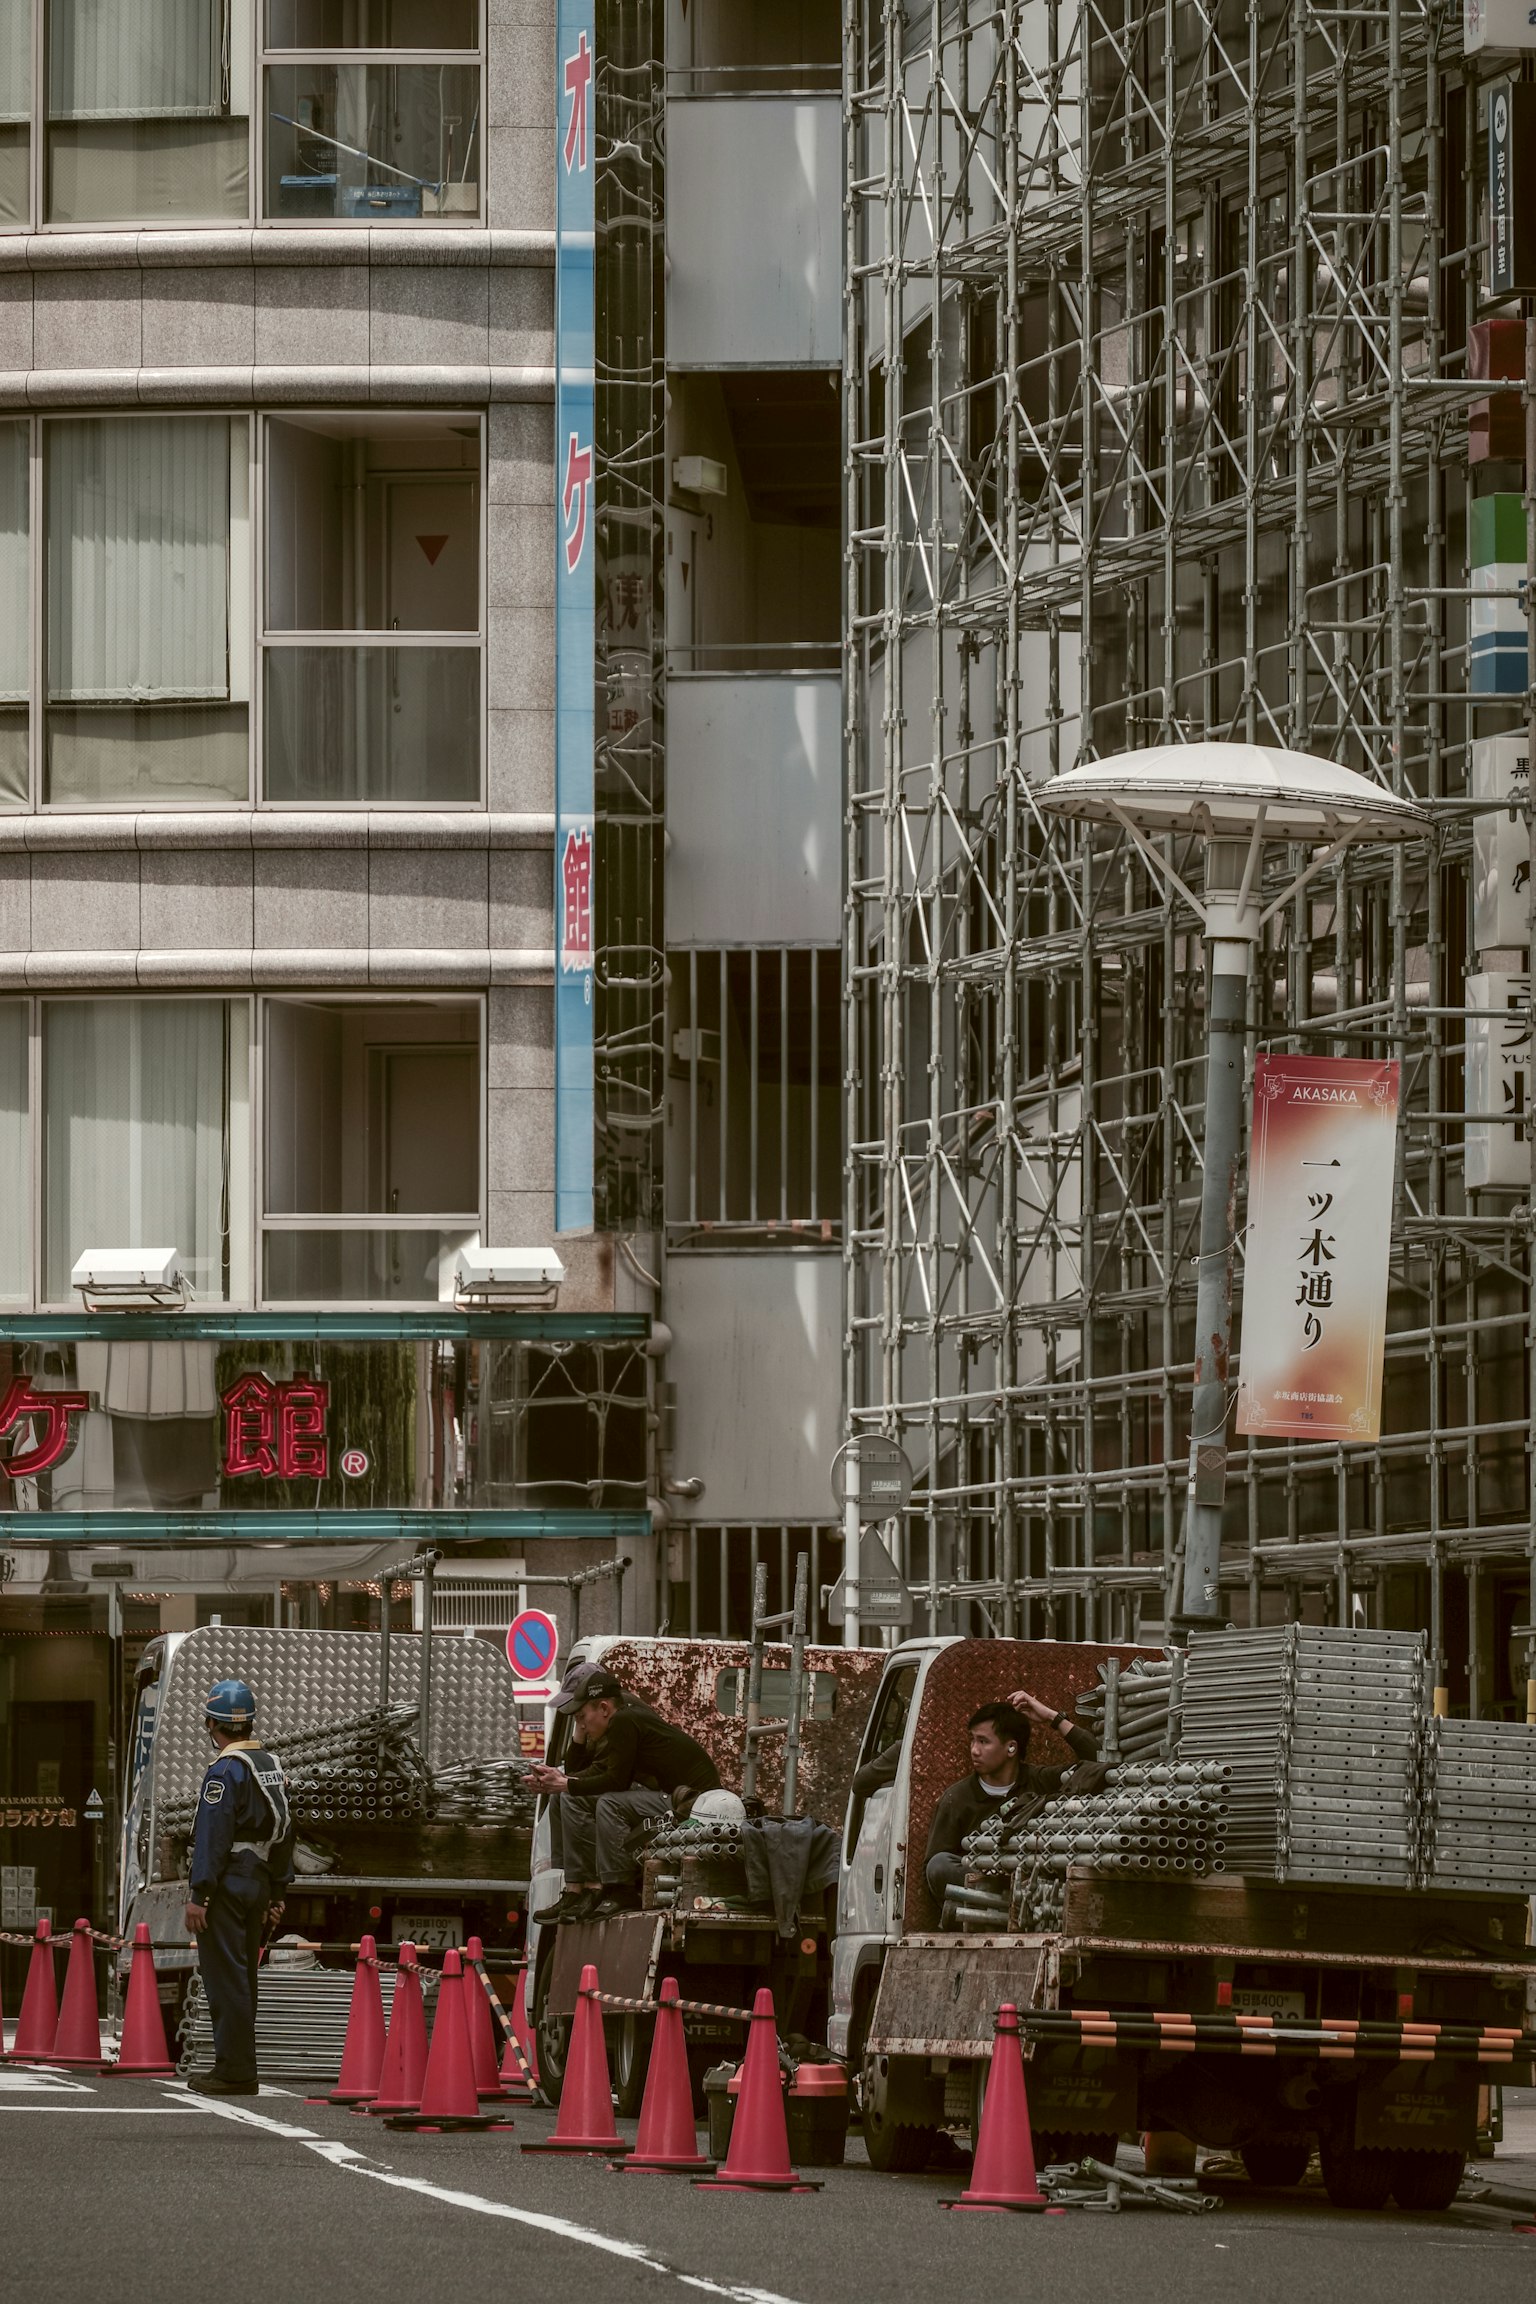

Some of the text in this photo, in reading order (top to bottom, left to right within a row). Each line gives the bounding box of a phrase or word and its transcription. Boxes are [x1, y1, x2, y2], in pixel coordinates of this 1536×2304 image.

[1293, 1087, 1358, 1103] AKASAKA
[1296, 1158, 1341, 1353] 一ツ木通り
[1273, 1390, 1343, 1404] 赤坂商店街協議会
[1301, 1412, 1314, 1420] TBS
[0, 1796, 65, 1805] KARAOKE KAN
[1052, 2077, 1102, 2088] ISUZU
[1396, 2093, 1445, 2105] ISUZU
